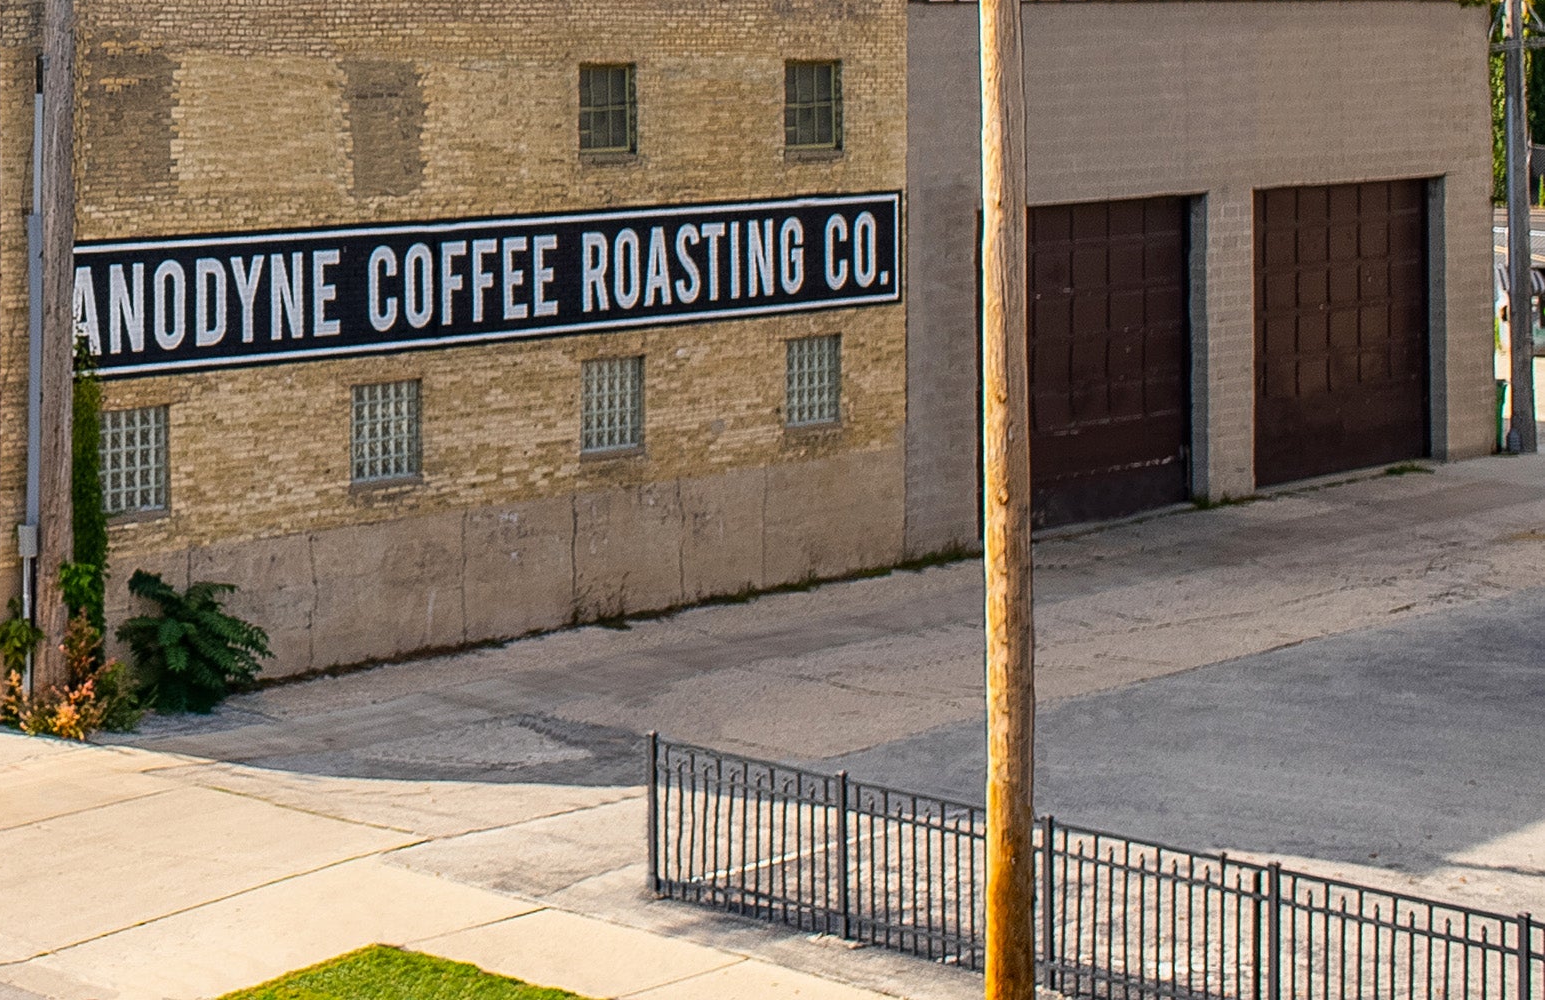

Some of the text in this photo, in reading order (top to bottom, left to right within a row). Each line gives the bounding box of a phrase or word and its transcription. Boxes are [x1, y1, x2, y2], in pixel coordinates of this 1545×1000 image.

[72, 210, 889, 357] ANODYNE COFFEE ROASTING CO.
